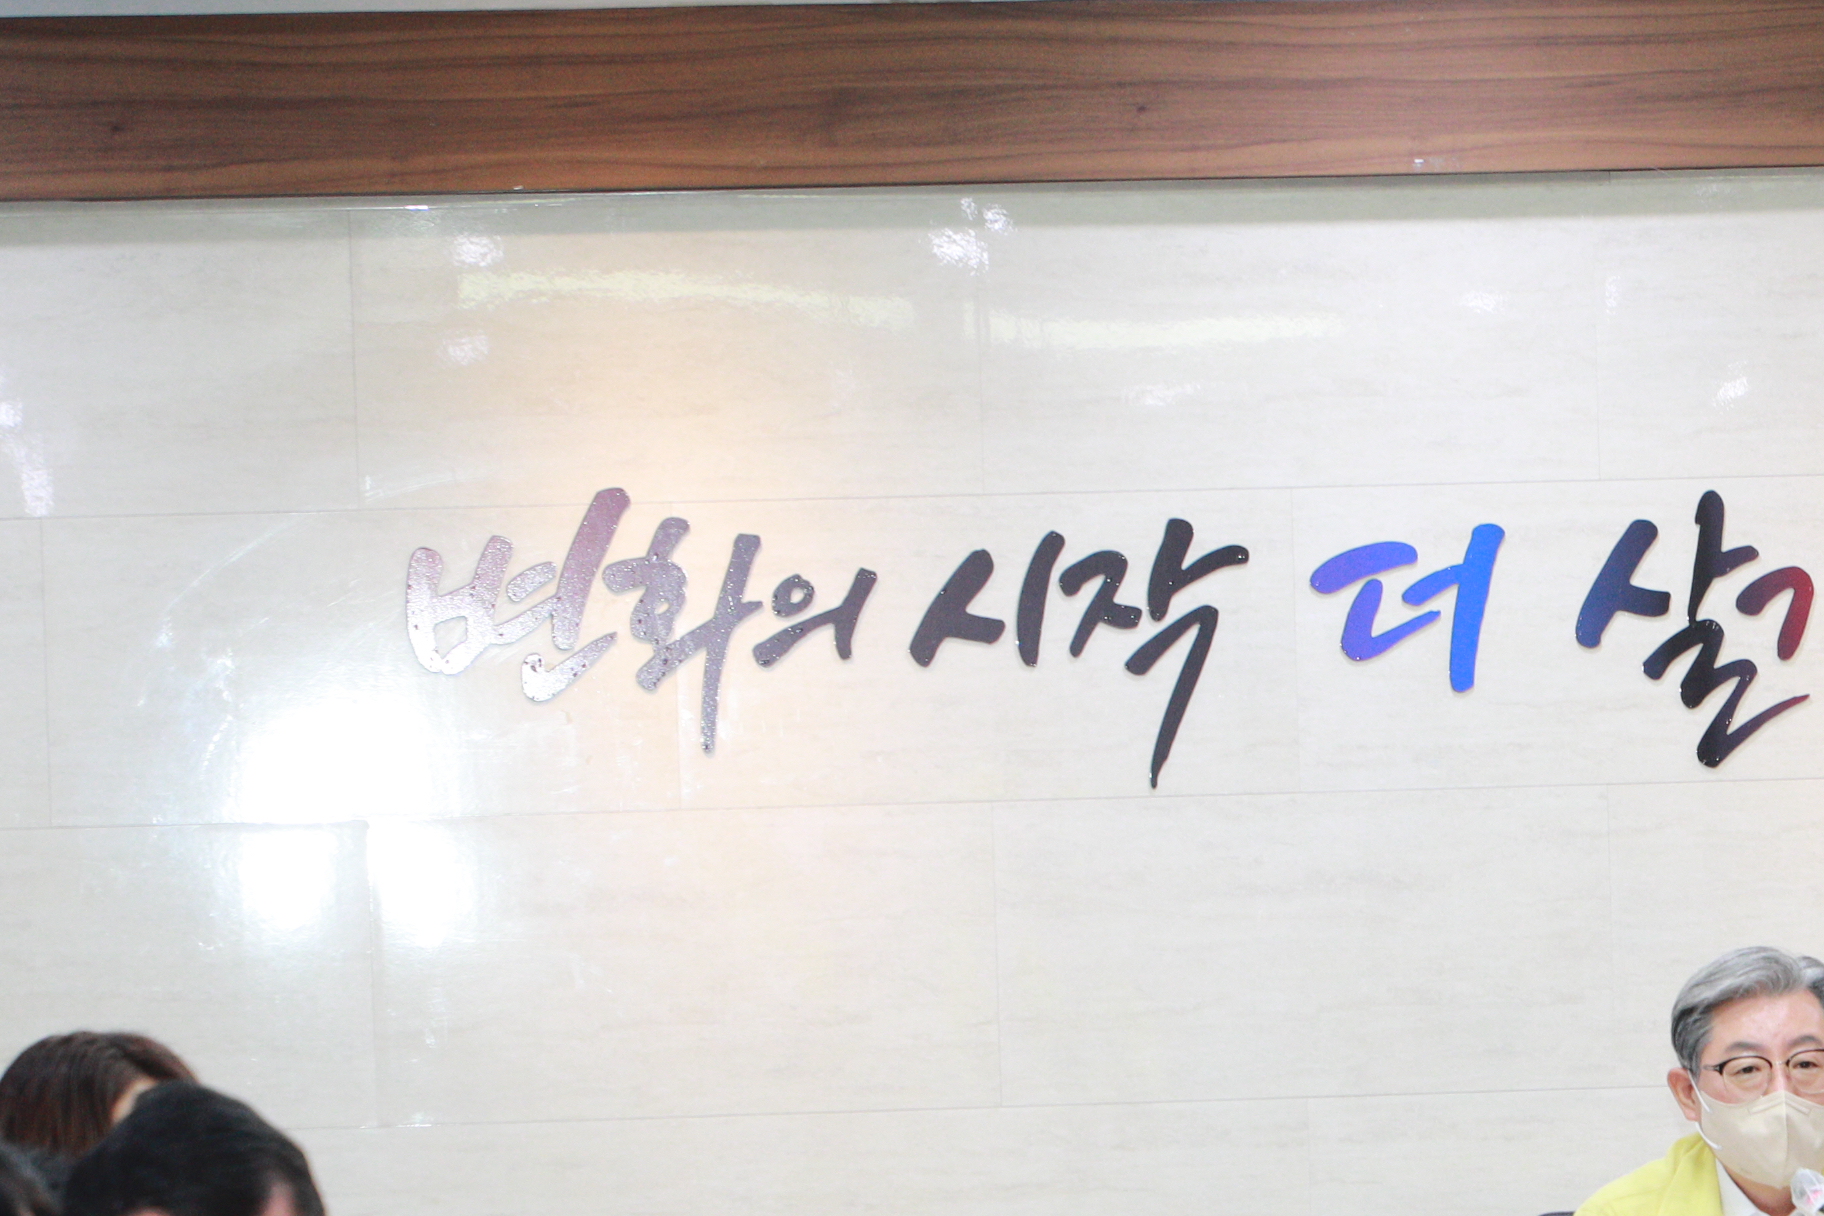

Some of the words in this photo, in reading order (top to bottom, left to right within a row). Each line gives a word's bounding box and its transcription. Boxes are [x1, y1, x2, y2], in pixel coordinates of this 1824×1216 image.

[406, 486, 878, 753] 변화의
[907, 516, 1250, 789] 시작
[1309, 523, 1506, 693] 더
